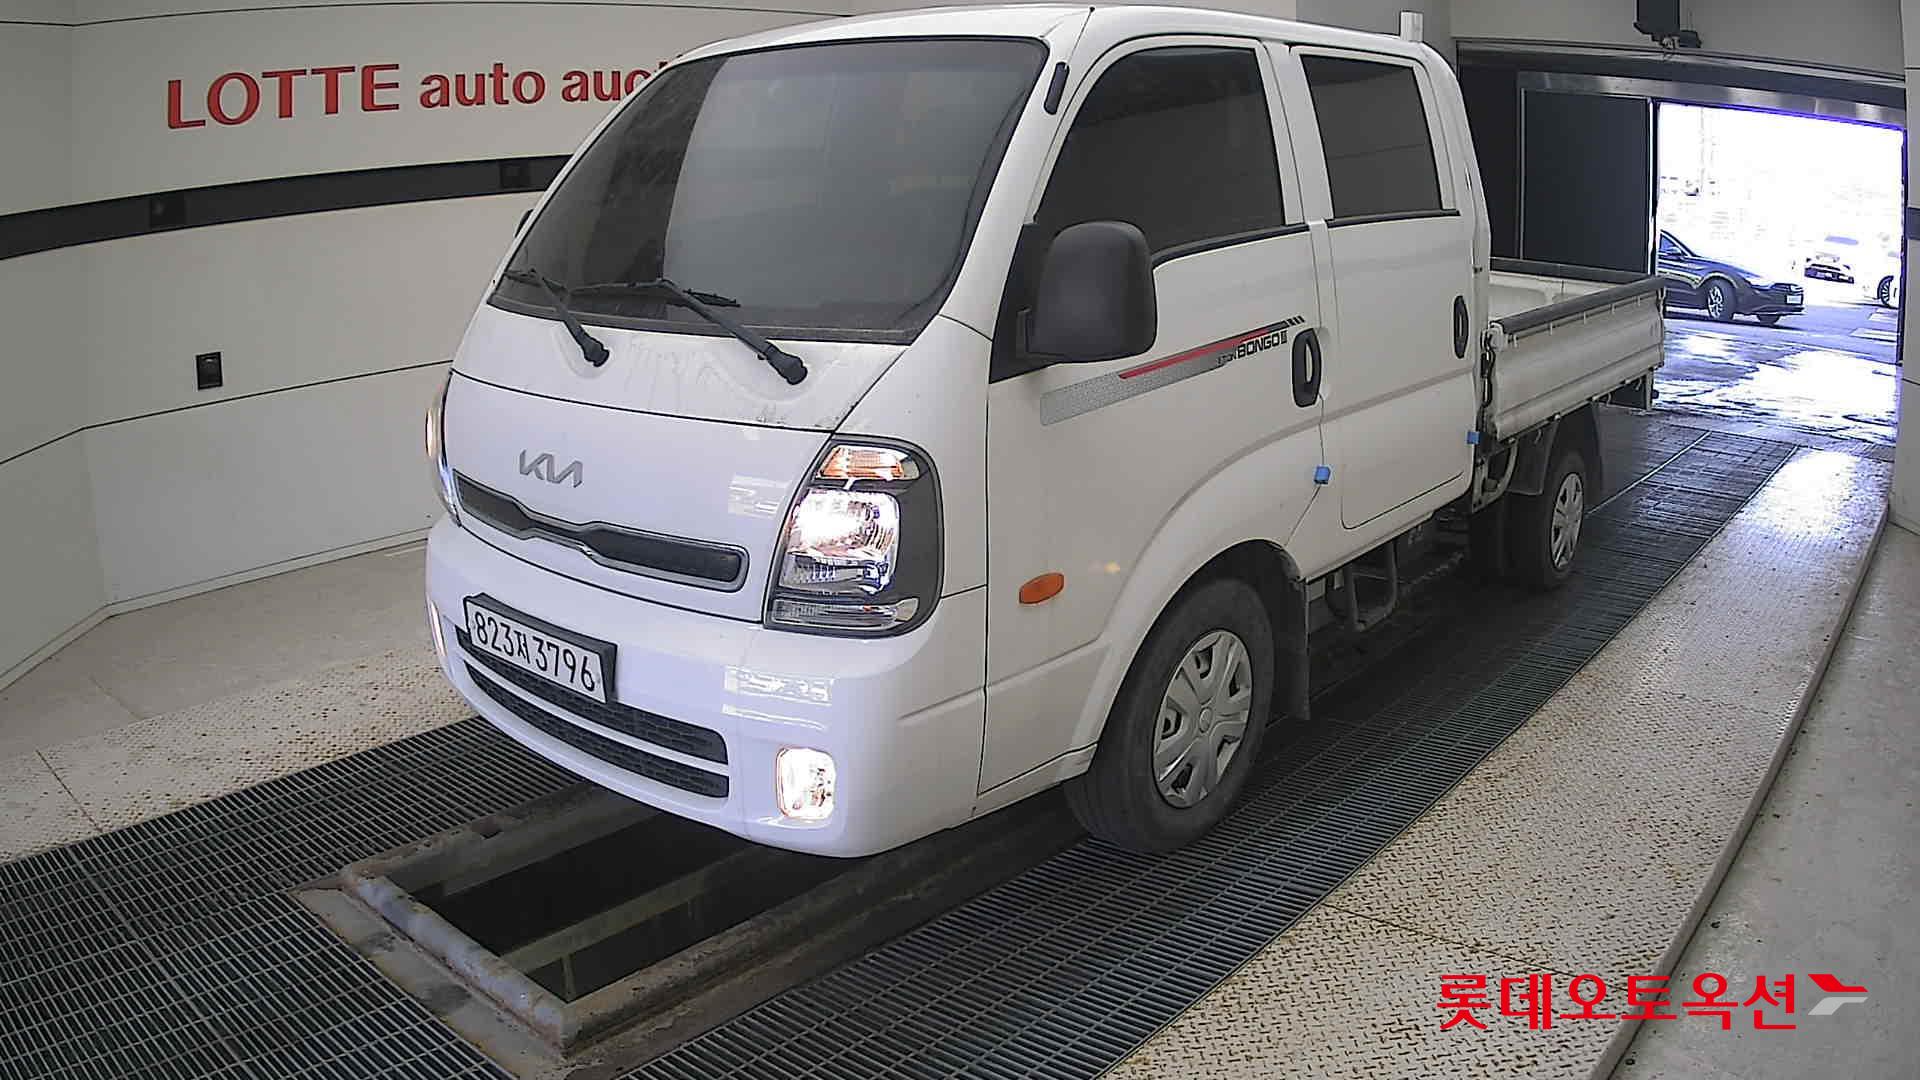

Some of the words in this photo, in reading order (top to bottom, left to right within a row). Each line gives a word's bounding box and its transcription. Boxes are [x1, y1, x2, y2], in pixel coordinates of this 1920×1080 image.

[167, 63, 400, 129] LOTTE
[419, 62, 546, 108] auto
[561, 61, 668, 102] auc
[1237, 332, 1280, 359] BONGO
[519, 449, 583, 488] KIA
